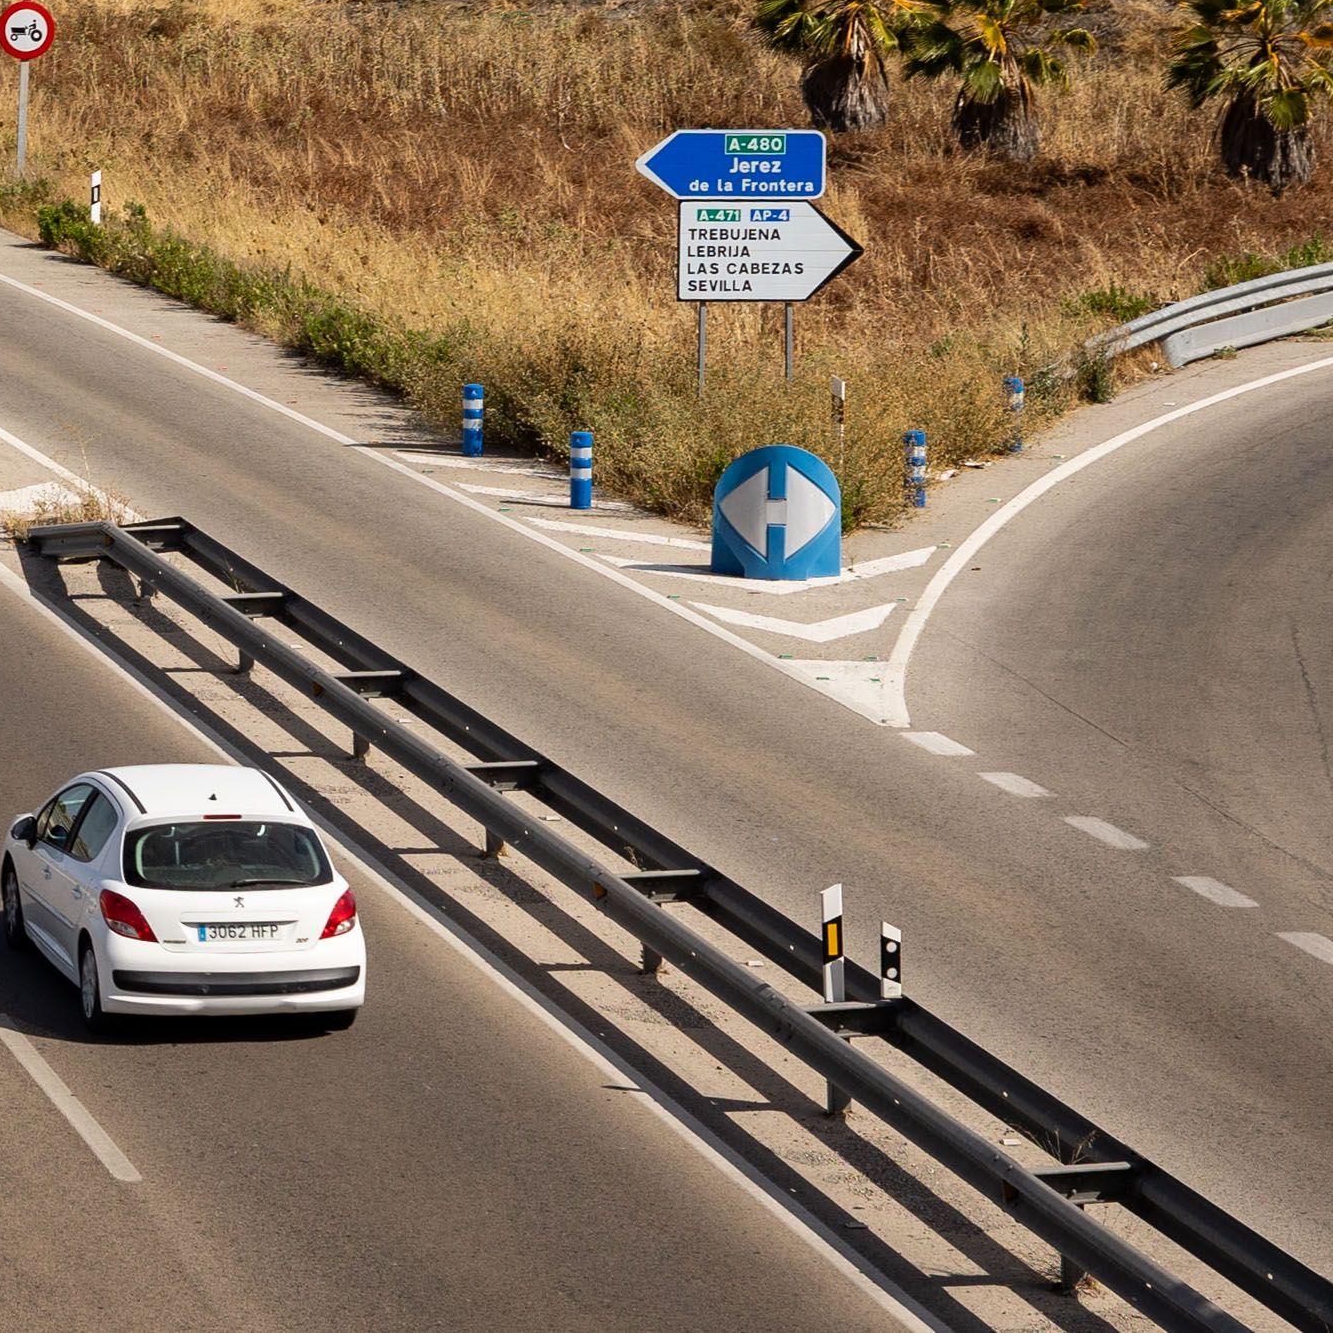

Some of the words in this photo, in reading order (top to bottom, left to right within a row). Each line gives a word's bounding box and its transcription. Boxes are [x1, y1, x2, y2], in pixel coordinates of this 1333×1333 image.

[728, 137, 783, 152] A-480
[729, 157, 782, 174] Jerez
[689, 179, 709, 192] de
[717, 178, 733, 192] la
[741, 178, 815, 192] Frontera
[698, 210, 740, 221] A-471
[752, 210, 788, 221] AP-4
[688, 228, 781, 241] TREBUJENA
[687, 245, 751, 258] LEBRIJA
[687, 262, 720, 275] LAS
[726, 262, 805, 275] CABEZAS
[687, 279, 753, 292] SEVILLA
[209, 925, 247, 938] 3062
[252, 924, 278, 938] HFP
